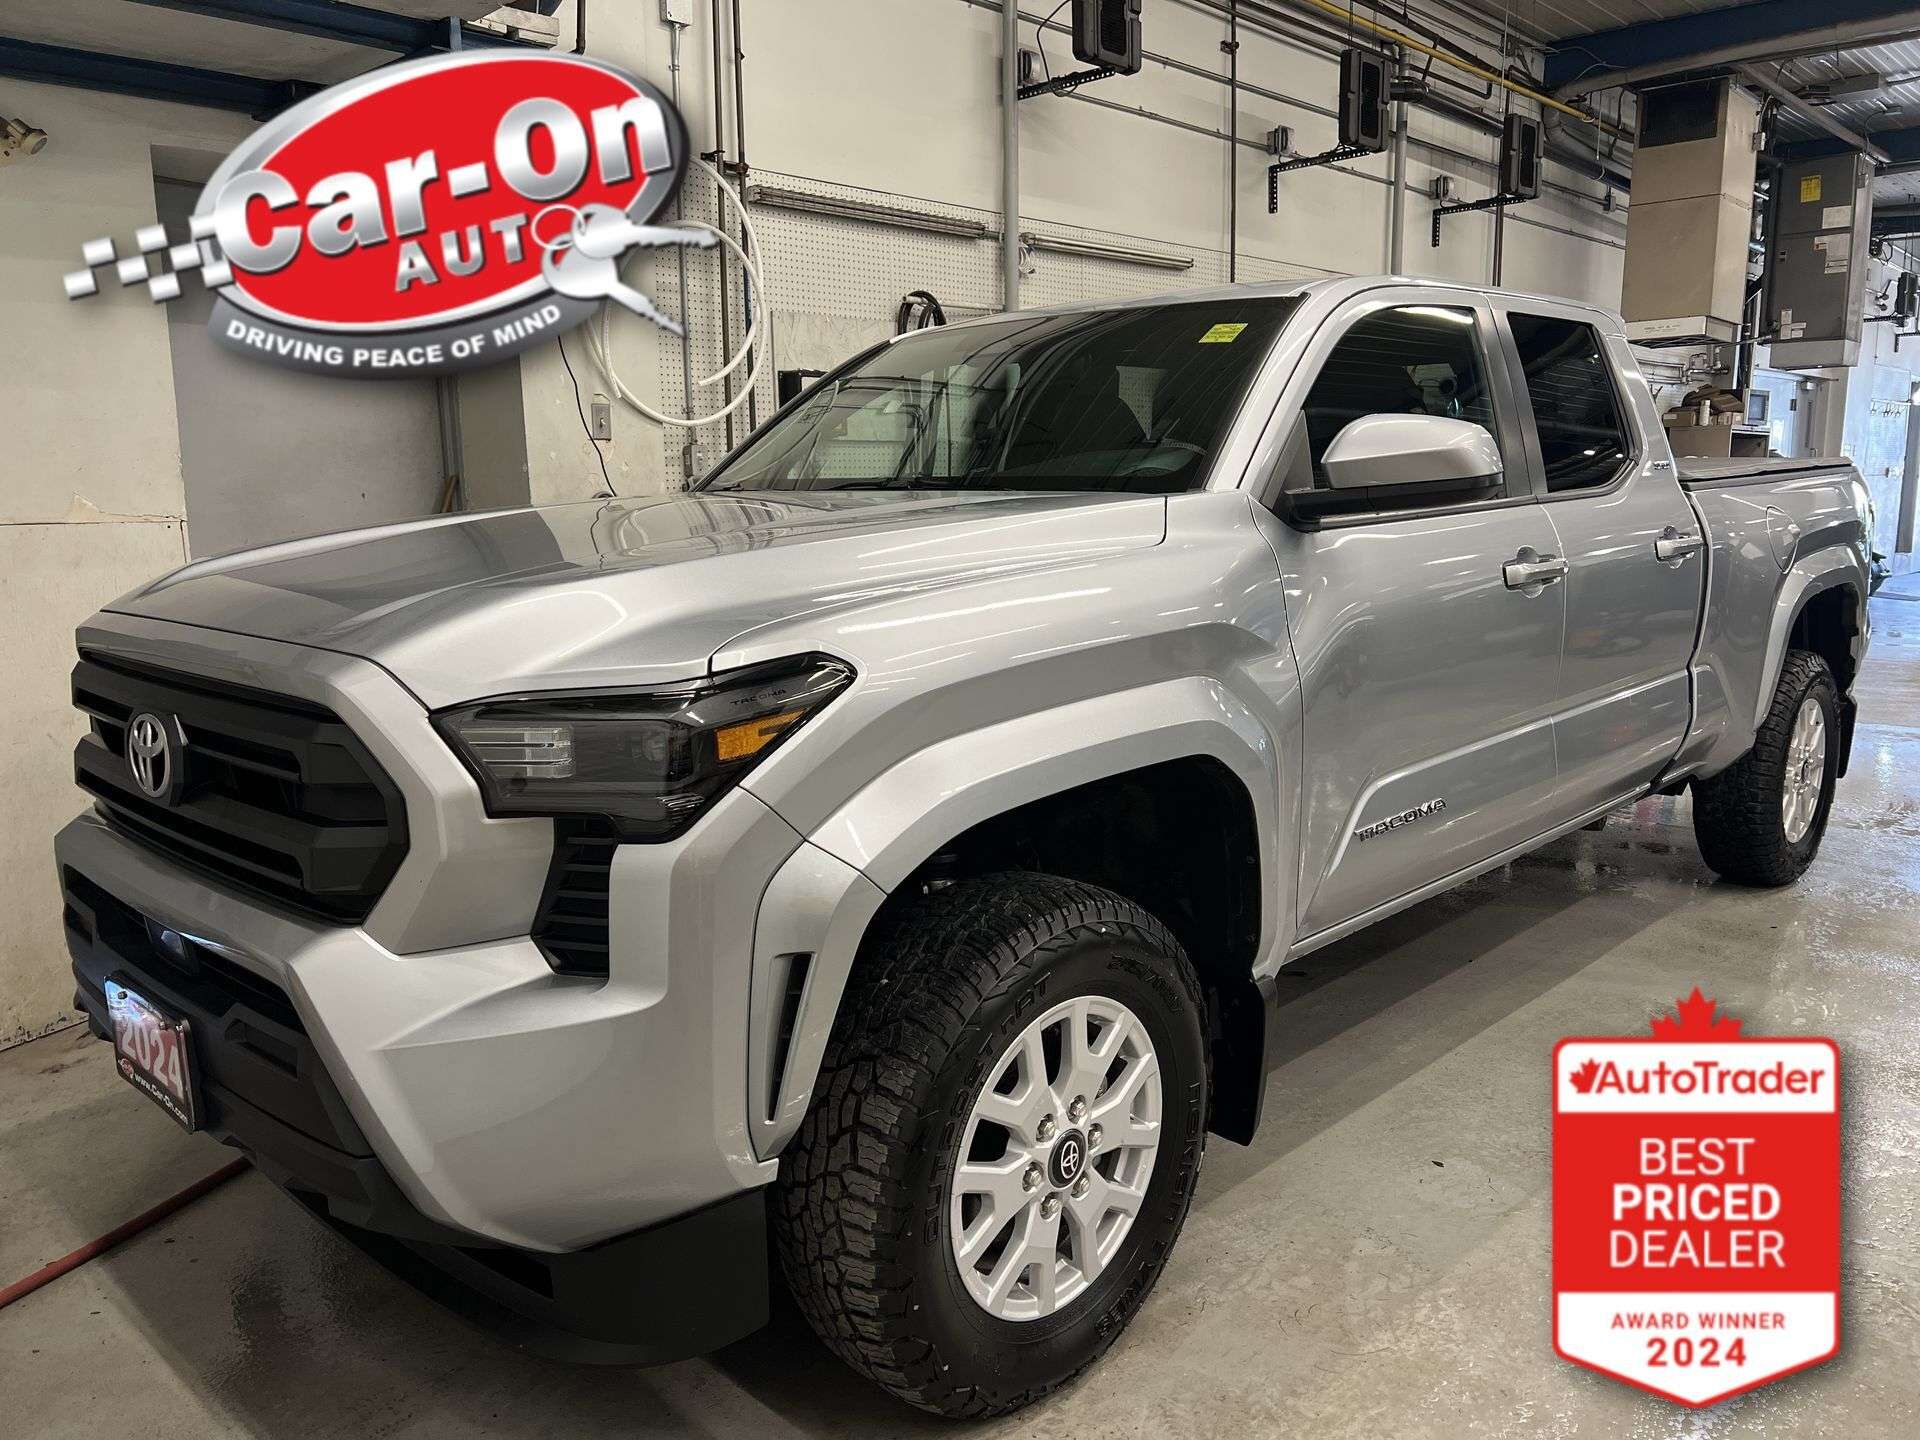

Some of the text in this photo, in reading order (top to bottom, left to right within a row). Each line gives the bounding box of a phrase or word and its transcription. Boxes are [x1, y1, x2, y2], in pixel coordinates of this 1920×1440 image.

[730, 688, 787, 706] TACOMA
[1354, 797, 1447, 842] TACOMA
[120, 1016, 186, 1100] 2024
